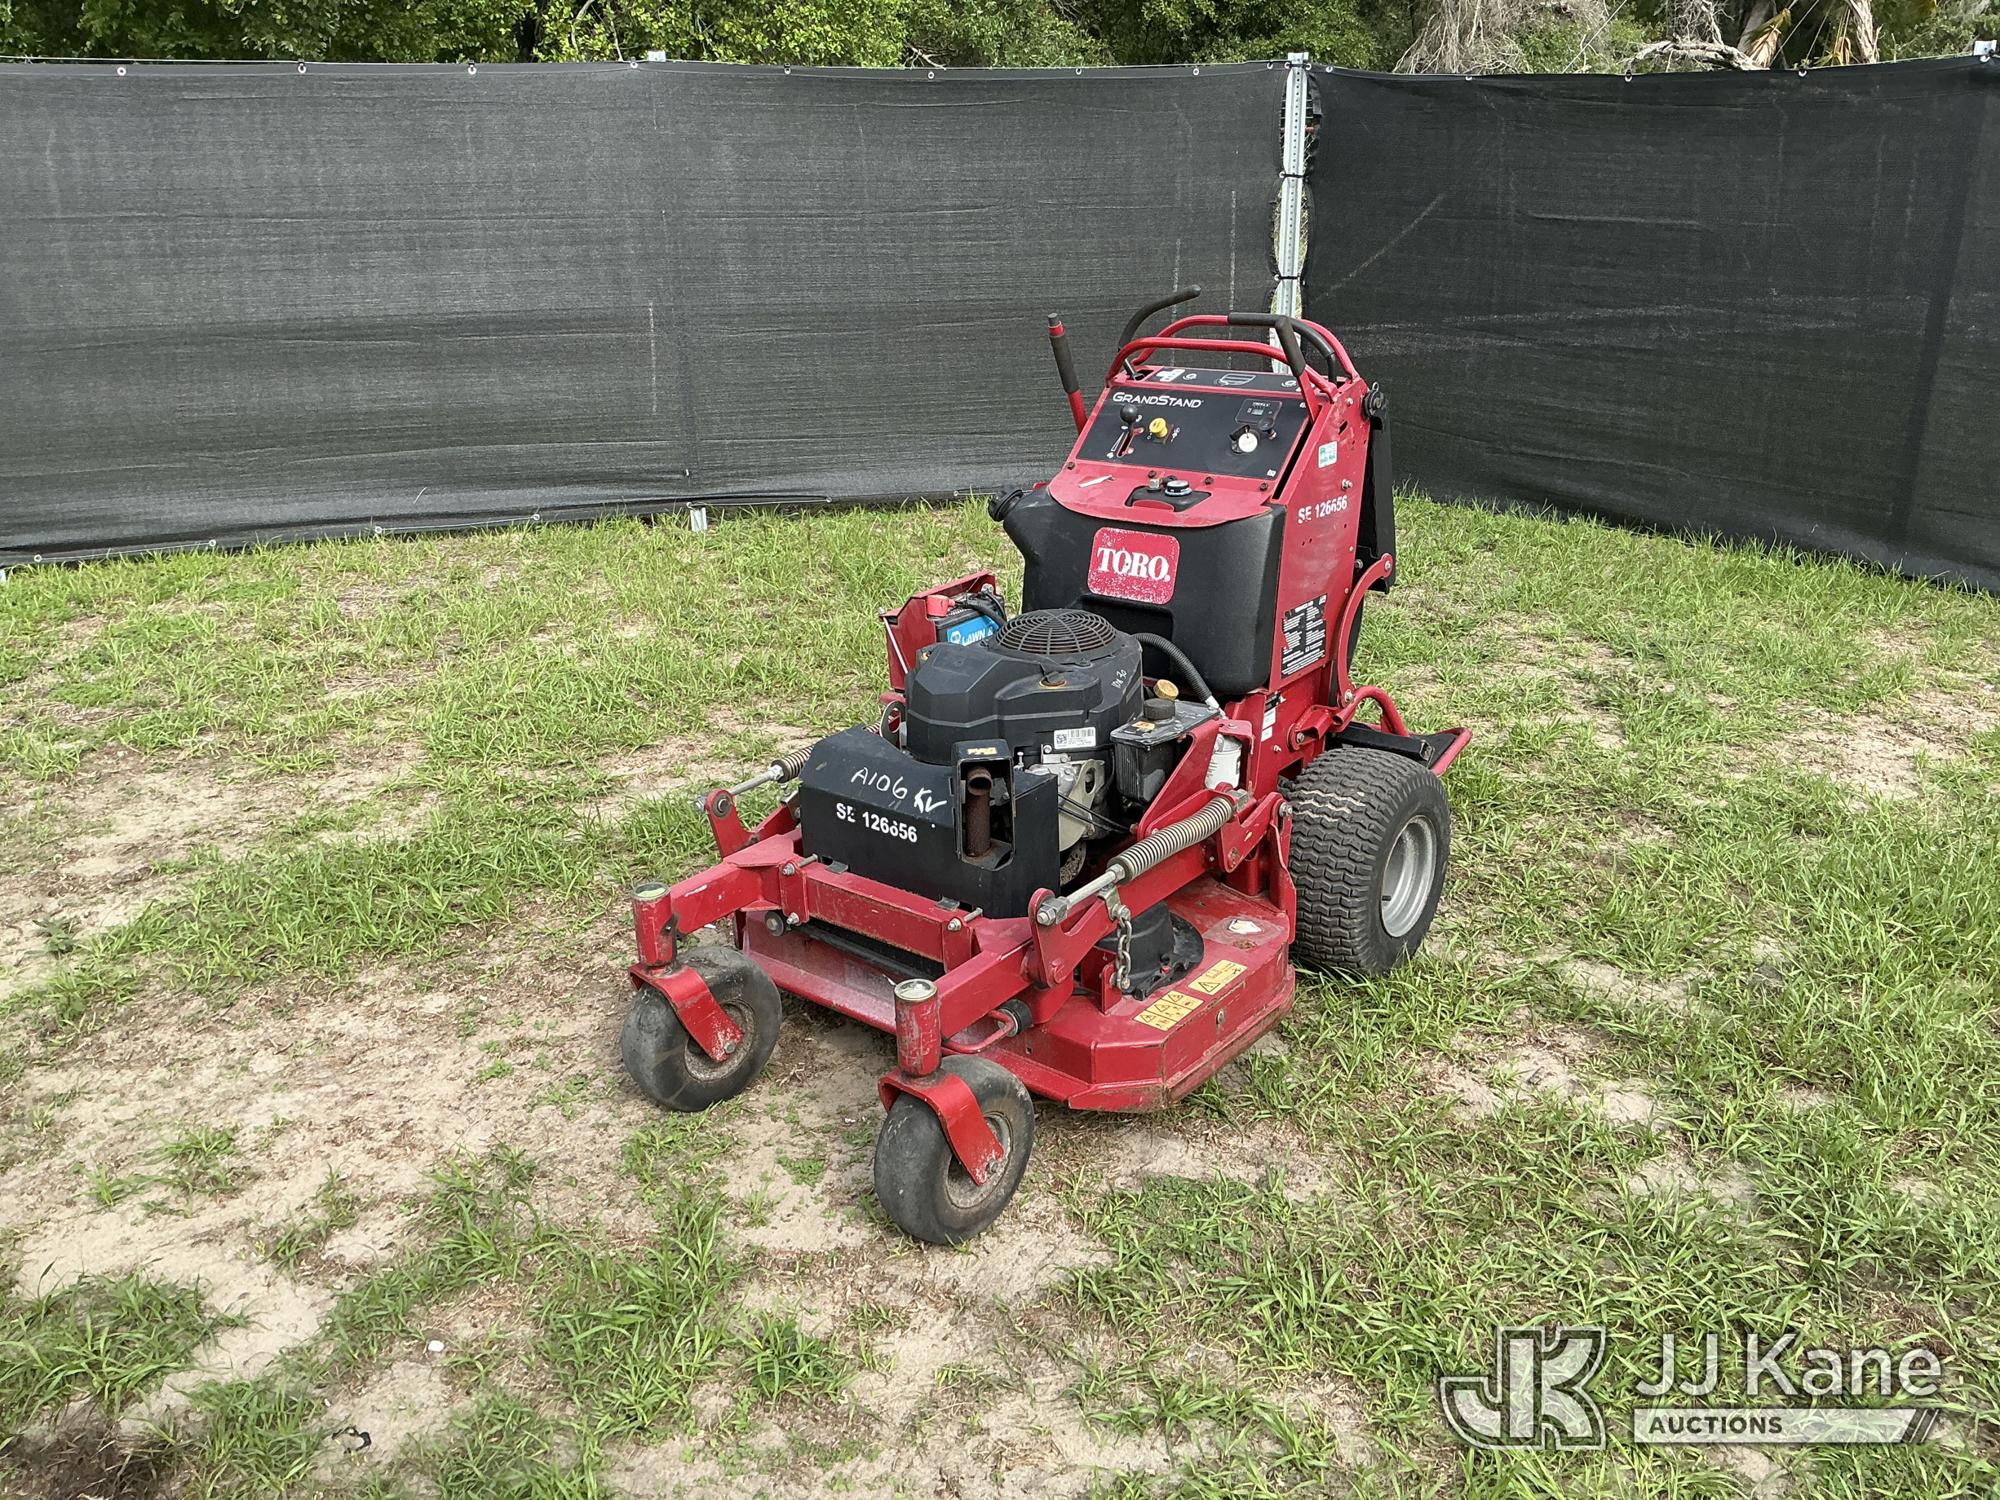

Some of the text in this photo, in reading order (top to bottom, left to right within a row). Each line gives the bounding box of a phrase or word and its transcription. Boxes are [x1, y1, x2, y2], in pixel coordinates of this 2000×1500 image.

[1298, 495, 1348, 524] SE 126656
[961, 629, 986, 647] LAWN
[836, 802, 918, 843] SE 126656
